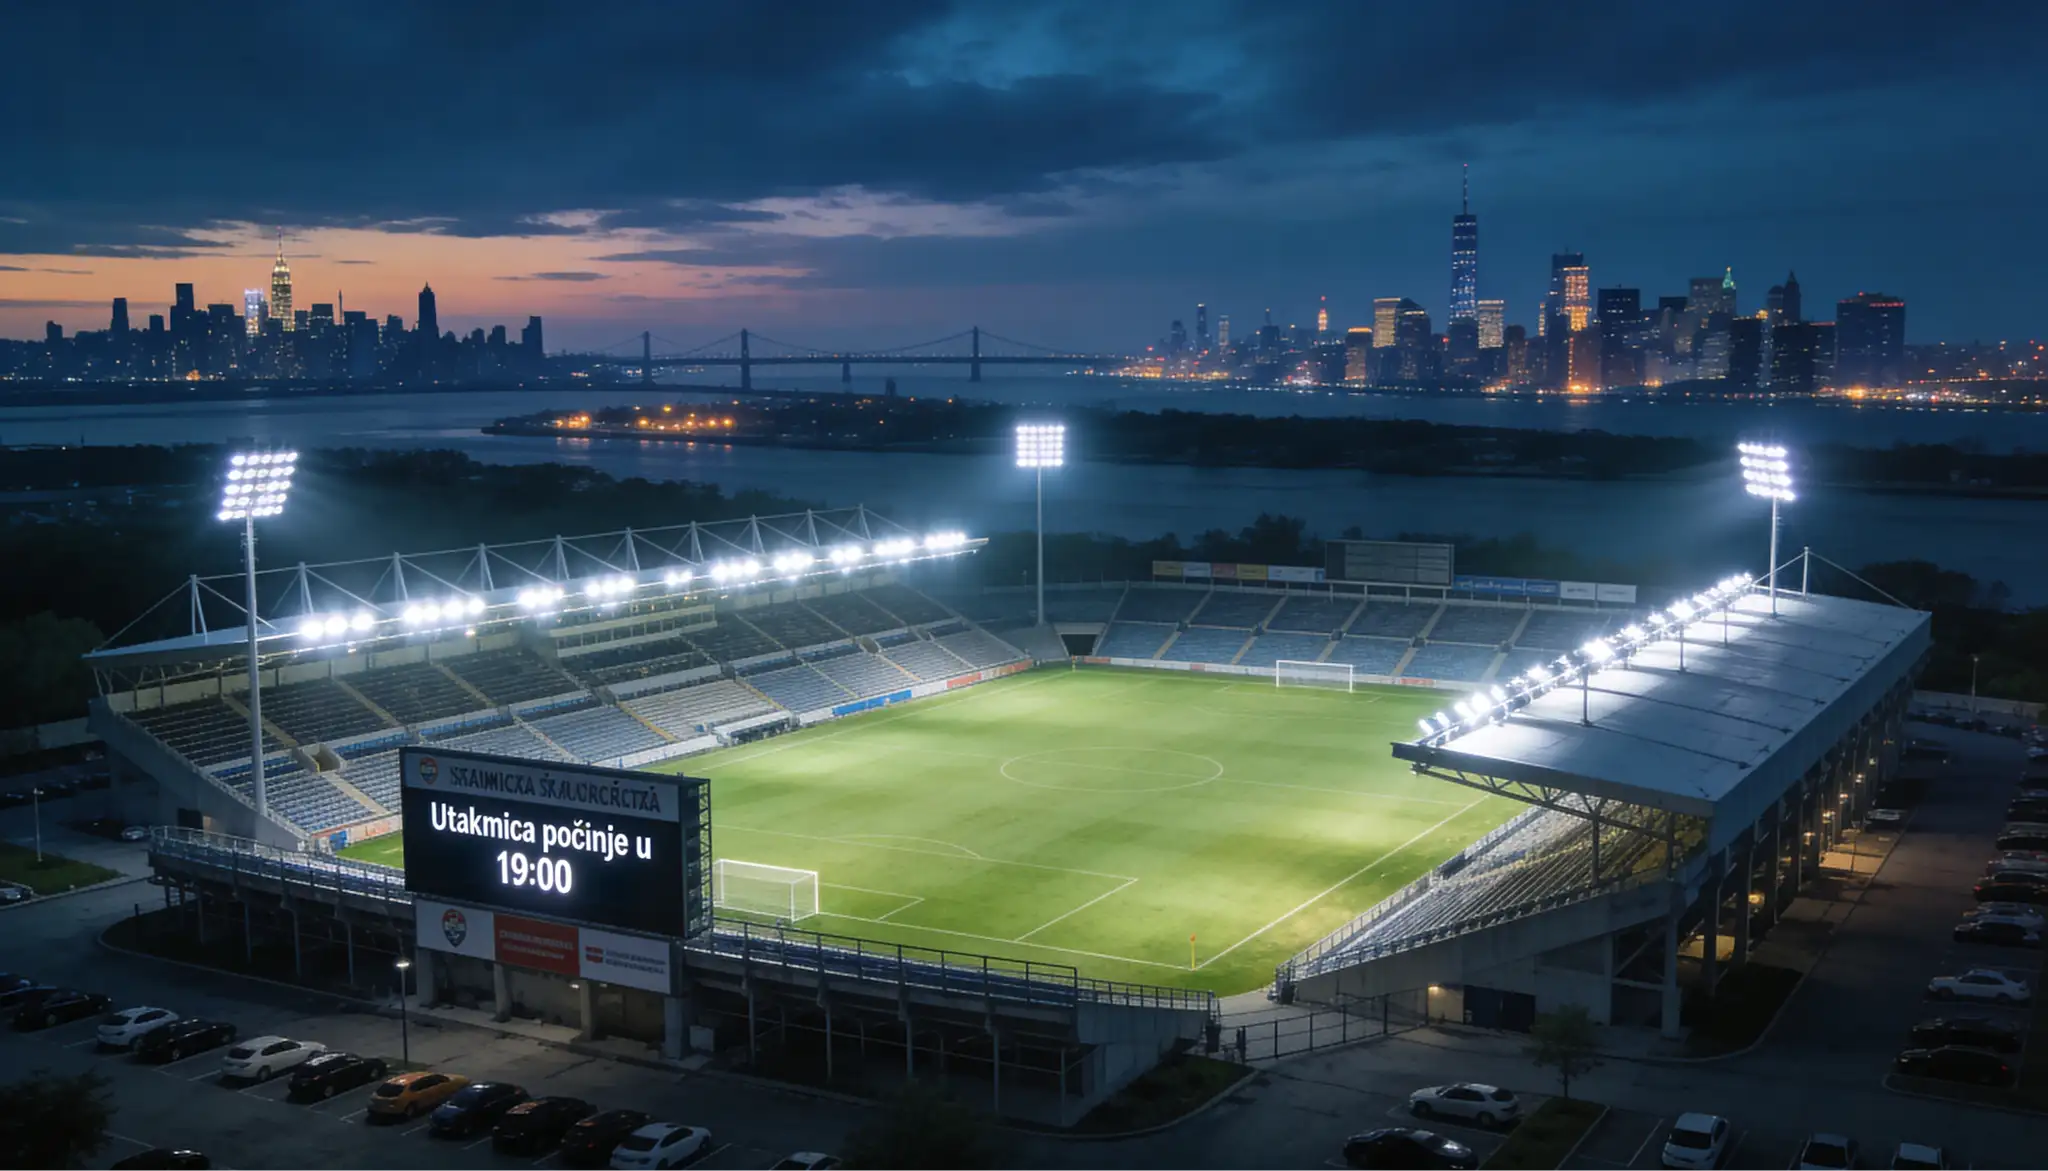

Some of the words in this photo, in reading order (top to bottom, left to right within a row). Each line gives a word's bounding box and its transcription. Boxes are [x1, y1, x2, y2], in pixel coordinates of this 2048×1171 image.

[430, 801, 536, 844] Utakmica
[542, 819, 629, 862] počinje
[636, 835, 652, 860] u
[496, 849, 574, 895] 19:00
